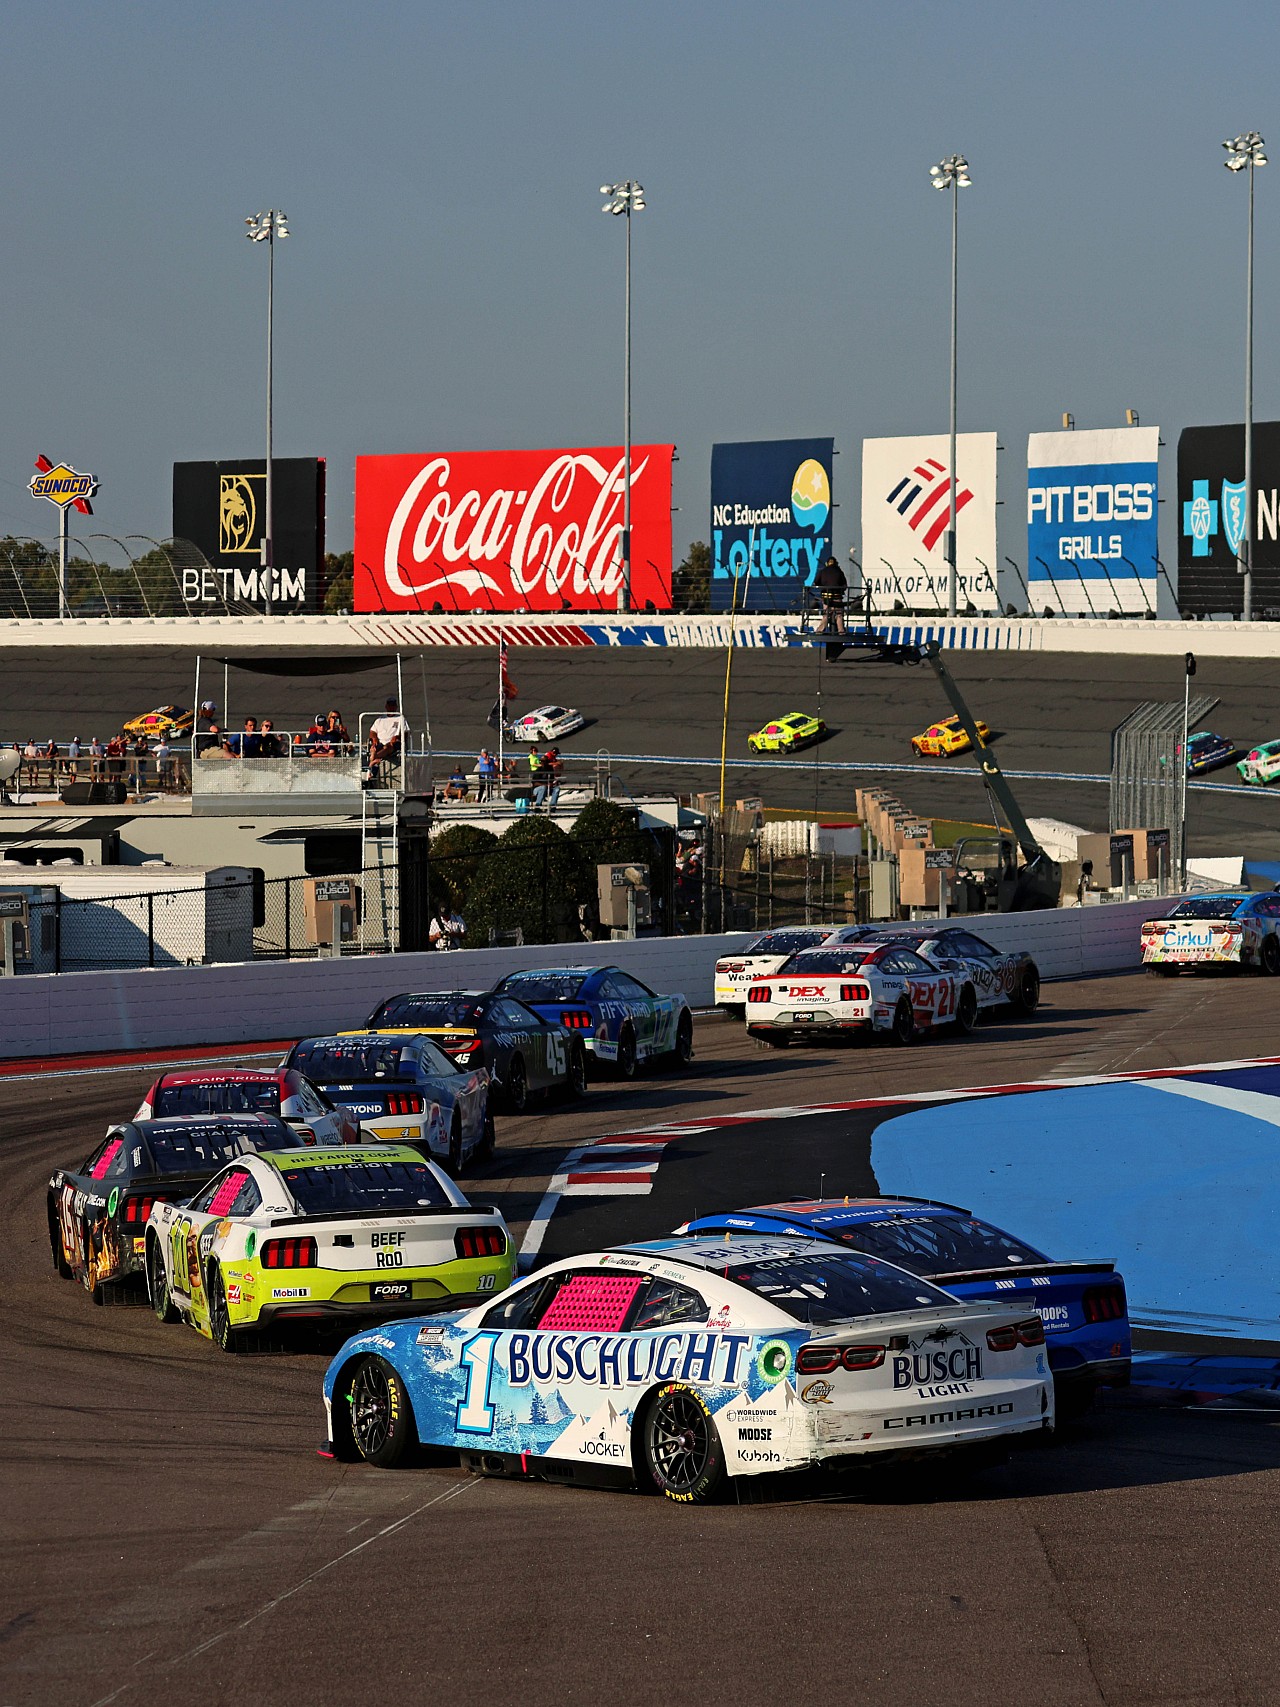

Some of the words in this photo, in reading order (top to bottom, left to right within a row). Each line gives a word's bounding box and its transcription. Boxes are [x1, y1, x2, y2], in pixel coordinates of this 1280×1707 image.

[35, 477, 89, 494] SUNOCO
[1028, 486, 1072, 524] PIT
[1073, 482, 1153, 523] BOSS
[713, 504, 731, 526] NC
[734, 503, 790, 525] Education
[1059, 535, 1122, 560] GRILLS
[713, 528, 824, 588] Lottery
[182, 568, 306, 601] BETMGM
[866, 576, 901, 594] BANK
[905, 576, 922, 592] OF
[927, 575, 994, 592] AMRICA
[664, 625, 763, 648] CHARLOTTE
[1163, 929, 1213, 946] Cirkul
[789, 986, 826, 997] DEX
[853, 1008, 864, 1017] 21
[454, 1054, 471, 1064] 45
[400, 1128, 410, 1138] 4
[833, 1209, 884, 1221] United
[887, 1206, 943, 1216] Rentals
[726, 1219, 756, 1227] PREECE
[870, 1216, 933, 1228] PREECE
[371, 1231, 406, 1248] BEEF
[755, 1255, 842, 1270] CHASTAIN
[477, 1275, 495, 1290] 10
[662, 1269, 686, 1281] SIEMENS
[273, 1288, 297, 1297] Mobil
[374, 1285, 408, 1295] FORD
[1035, 1306, 1069, 1321] ROOPS
[706, 1317, 732, 1330] Wendy's
[1052, 1321, 1070, 1329] Rentals
[893, 1346, 984, 1391] BUSCH
[1036, 1353, 1046, 1374] 1
[455, 1330, 503, 1436] 1
[917, 1382, 971, 1399] LIGHT
[387, 1377, 399, 1420] EAGLE
[737, 1409, 777, 1417] WORLDWIDE
[883, 1402, 1014, 1430] CAMARO
[738, 1428, 772, 1441] MOOSE
[579, 1440, 626, 1457] JOCKEY
[738, 1449, 780, 1463] Kubota
[664, 1487, 694, 1502] EAGLE
